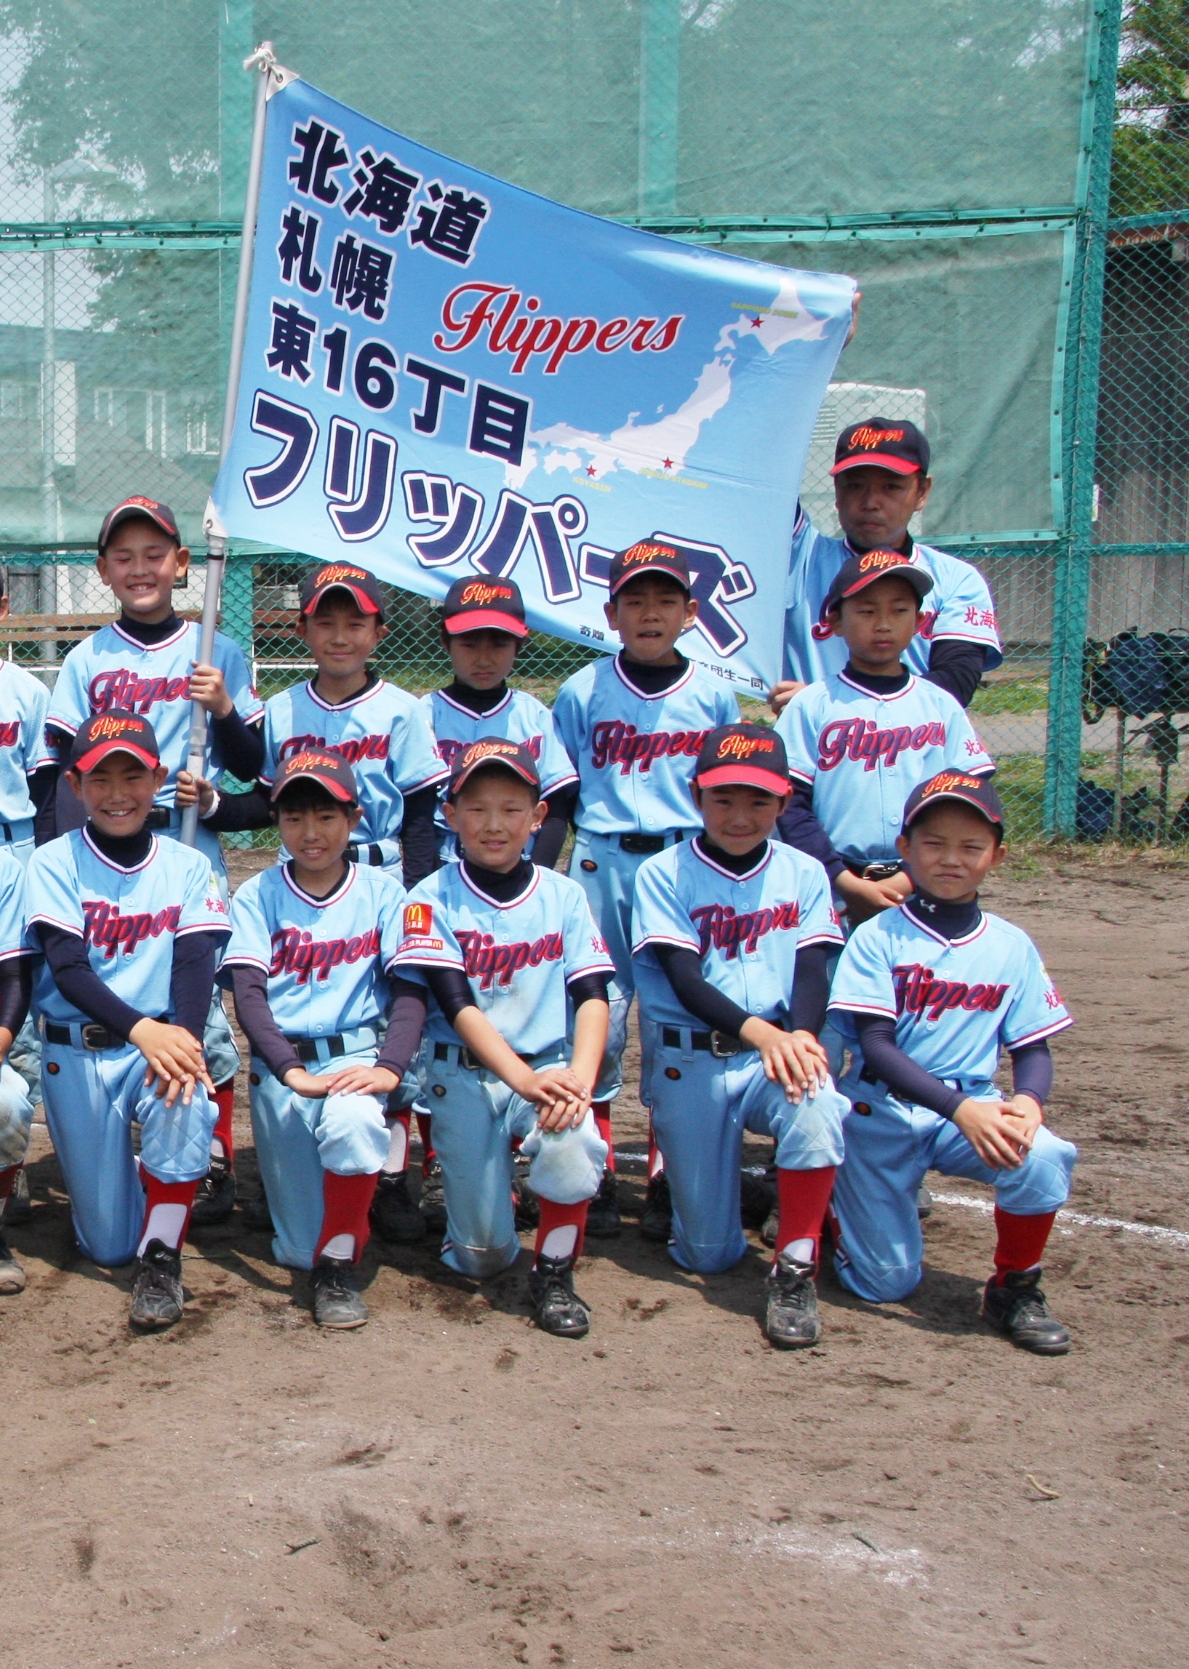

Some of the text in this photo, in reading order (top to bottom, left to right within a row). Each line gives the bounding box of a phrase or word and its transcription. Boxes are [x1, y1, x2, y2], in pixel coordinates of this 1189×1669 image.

[287, 115, 492, 268] 北海道
[275, 205, 396, 322] 札幌
[432, 279, 687, 376] Flippers
[266, 298, 532, 467] 東16丁目
[88, 668, 193, 715] Flipper
[82, 900, 182, 960] Flipper
[892, 963, 1011, 1024] Flippers
